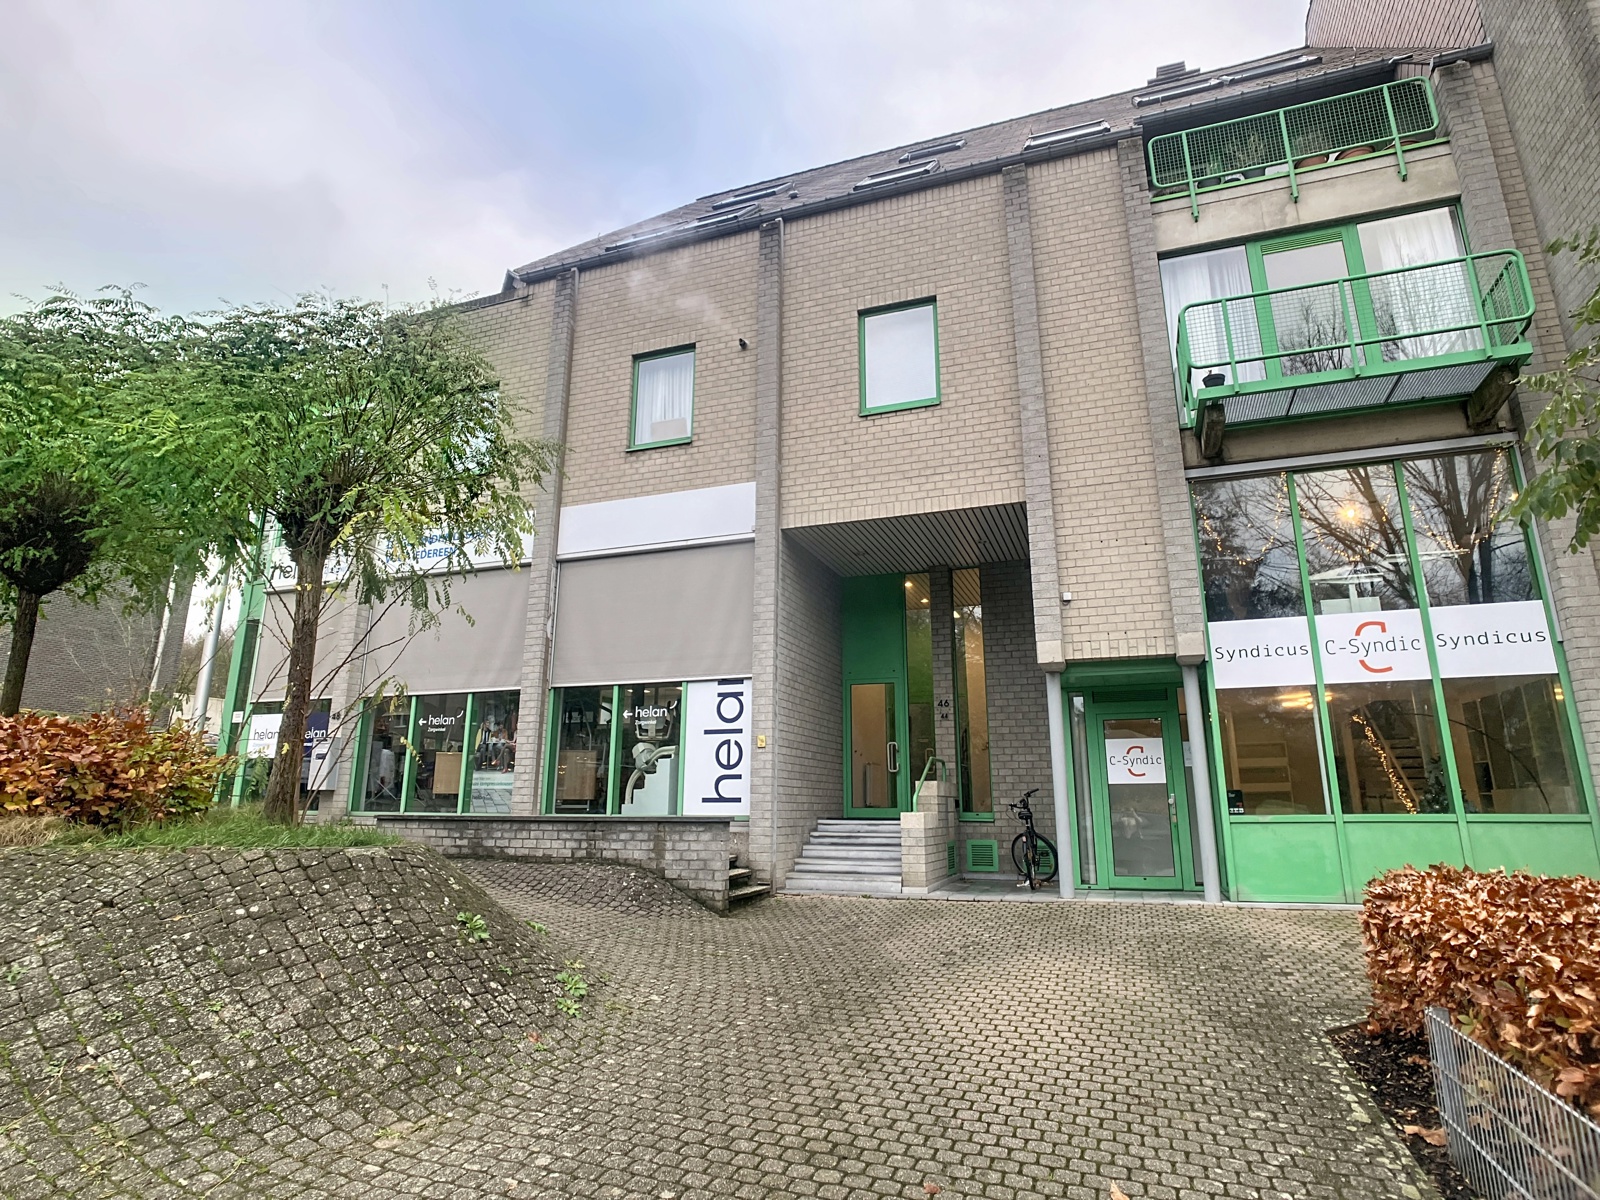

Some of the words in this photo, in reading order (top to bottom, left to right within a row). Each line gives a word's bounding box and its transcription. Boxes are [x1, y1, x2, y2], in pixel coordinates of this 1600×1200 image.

[412, 546, 458, 560] EDEREEN
[1325, 636, 1422, 657] C-Syndic
[1436, 630, 1546, 650] Syndicus
[1214, 644, 1309, 662] Syndicus
[937, 699, 950, 708] 46
[634, 705, 668, 718] helan
[428, 713, 455, 726] helan
[304, 727, 326, 739] elan
[701, 679, 744, 803] hela
[1109, 755, 1162, 768] C-Syndic
